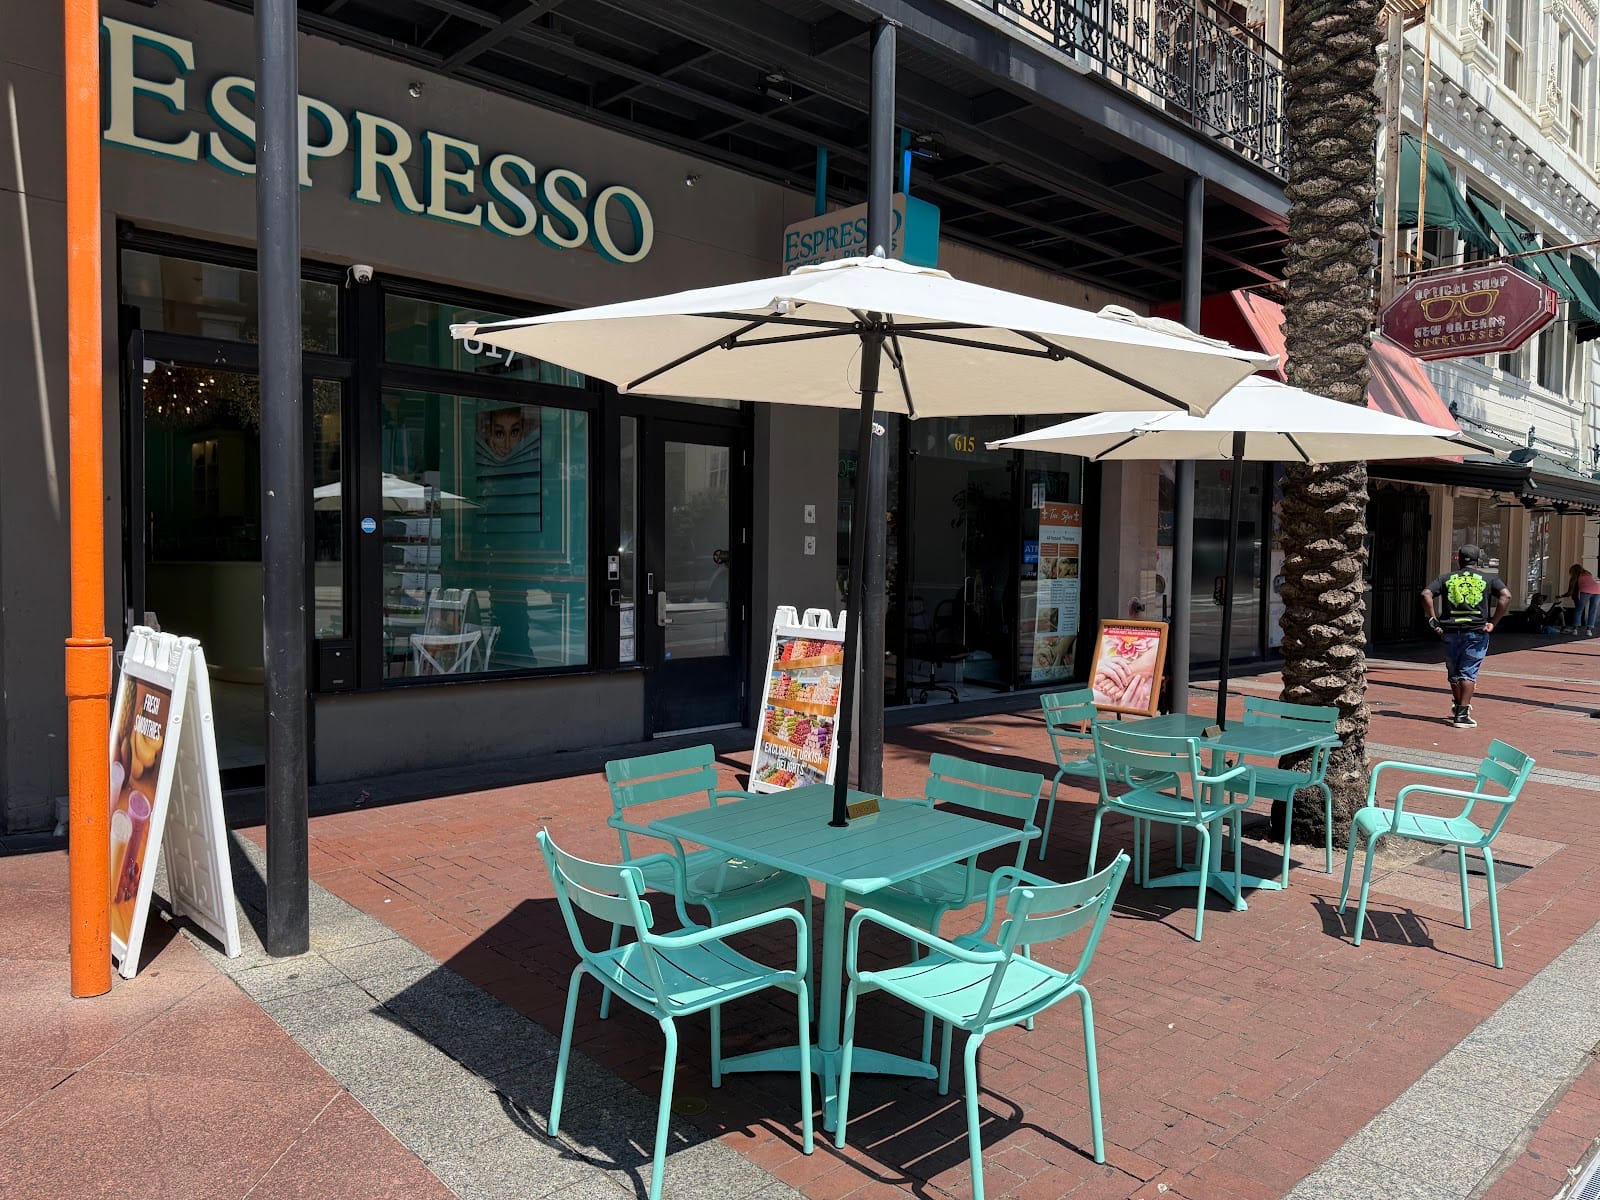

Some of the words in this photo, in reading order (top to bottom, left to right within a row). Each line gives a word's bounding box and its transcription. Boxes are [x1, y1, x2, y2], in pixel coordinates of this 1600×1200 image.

[102, 16, 655, 264] ESPRESSO
[785, 208, 902, 263] ESPRESO
[1414, 283, 1468, 300] OPTICAL
[1472, 275, 1508, 291] SHOP
[1413, 324, 1441, 338] NEW
[1445, 315, 1506, 333] ORLEANS
[954, 435, 975, 453] 615
[143, 694, 161, 716] FRESH
[134, 714, 162, 741] SMOOTHIES
[764, 742, 797, 759] EXCLUSIVE
[797, 748, 823, 765] TURKISH
[776, 758, 805, 776] DELIGHTS
